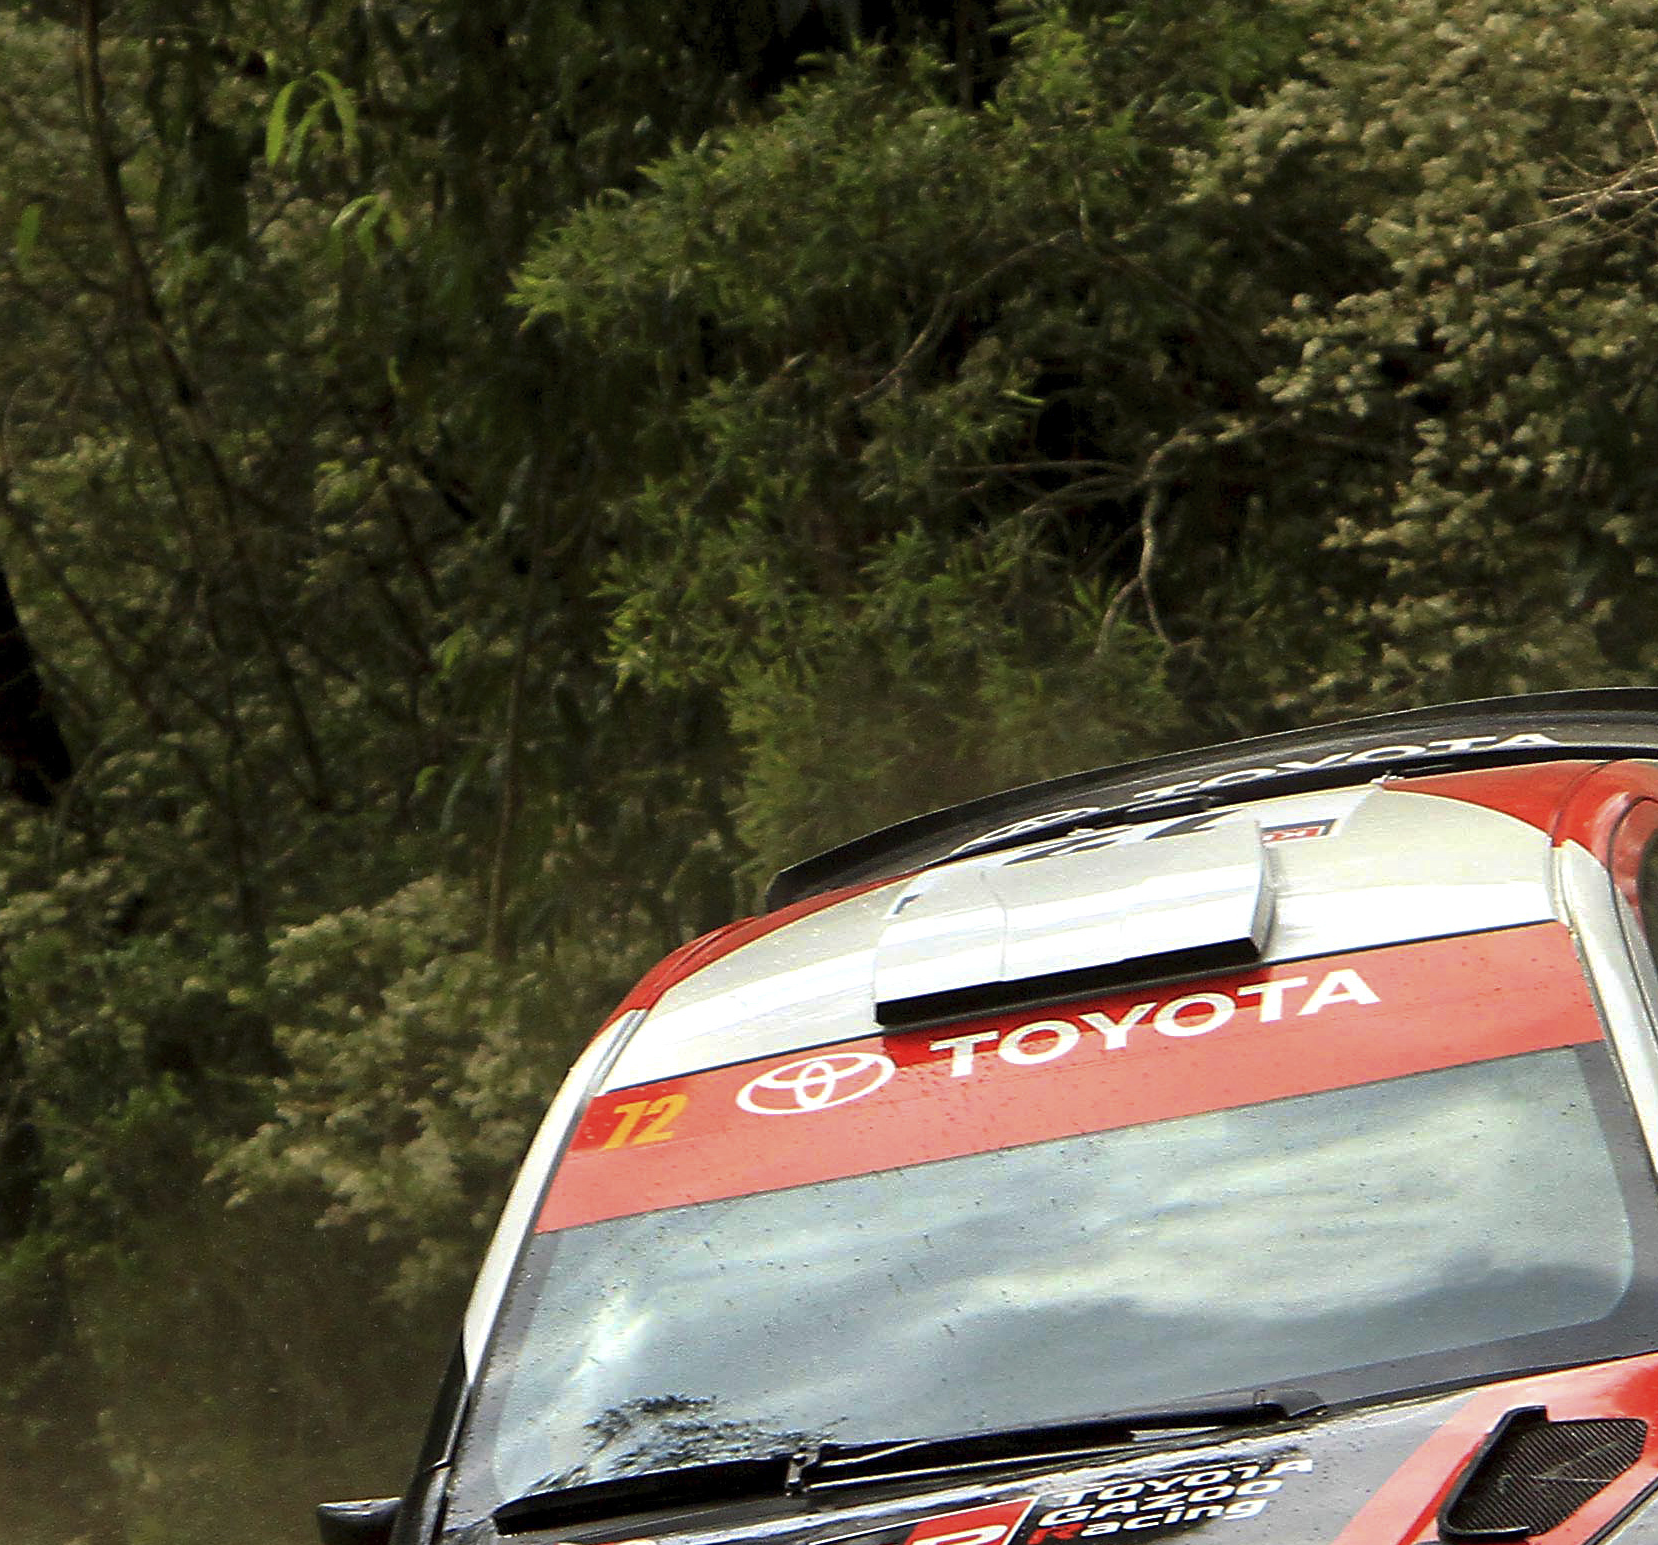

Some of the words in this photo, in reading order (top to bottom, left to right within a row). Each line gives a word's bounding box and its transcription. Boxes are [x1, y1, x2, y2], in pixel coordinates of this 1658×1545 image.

[1134, 734, 1560, 799] TOYOTA
[929, 969, 1380, 1078] TOYOTA
[601, 1093, 688, 1150] 72
[1038, 1479, 1283, 1527] GAZOO
[1050, 1459, 1313, 1506] TOYOTA
[1027, 1499, 1269, 1545] Racing
